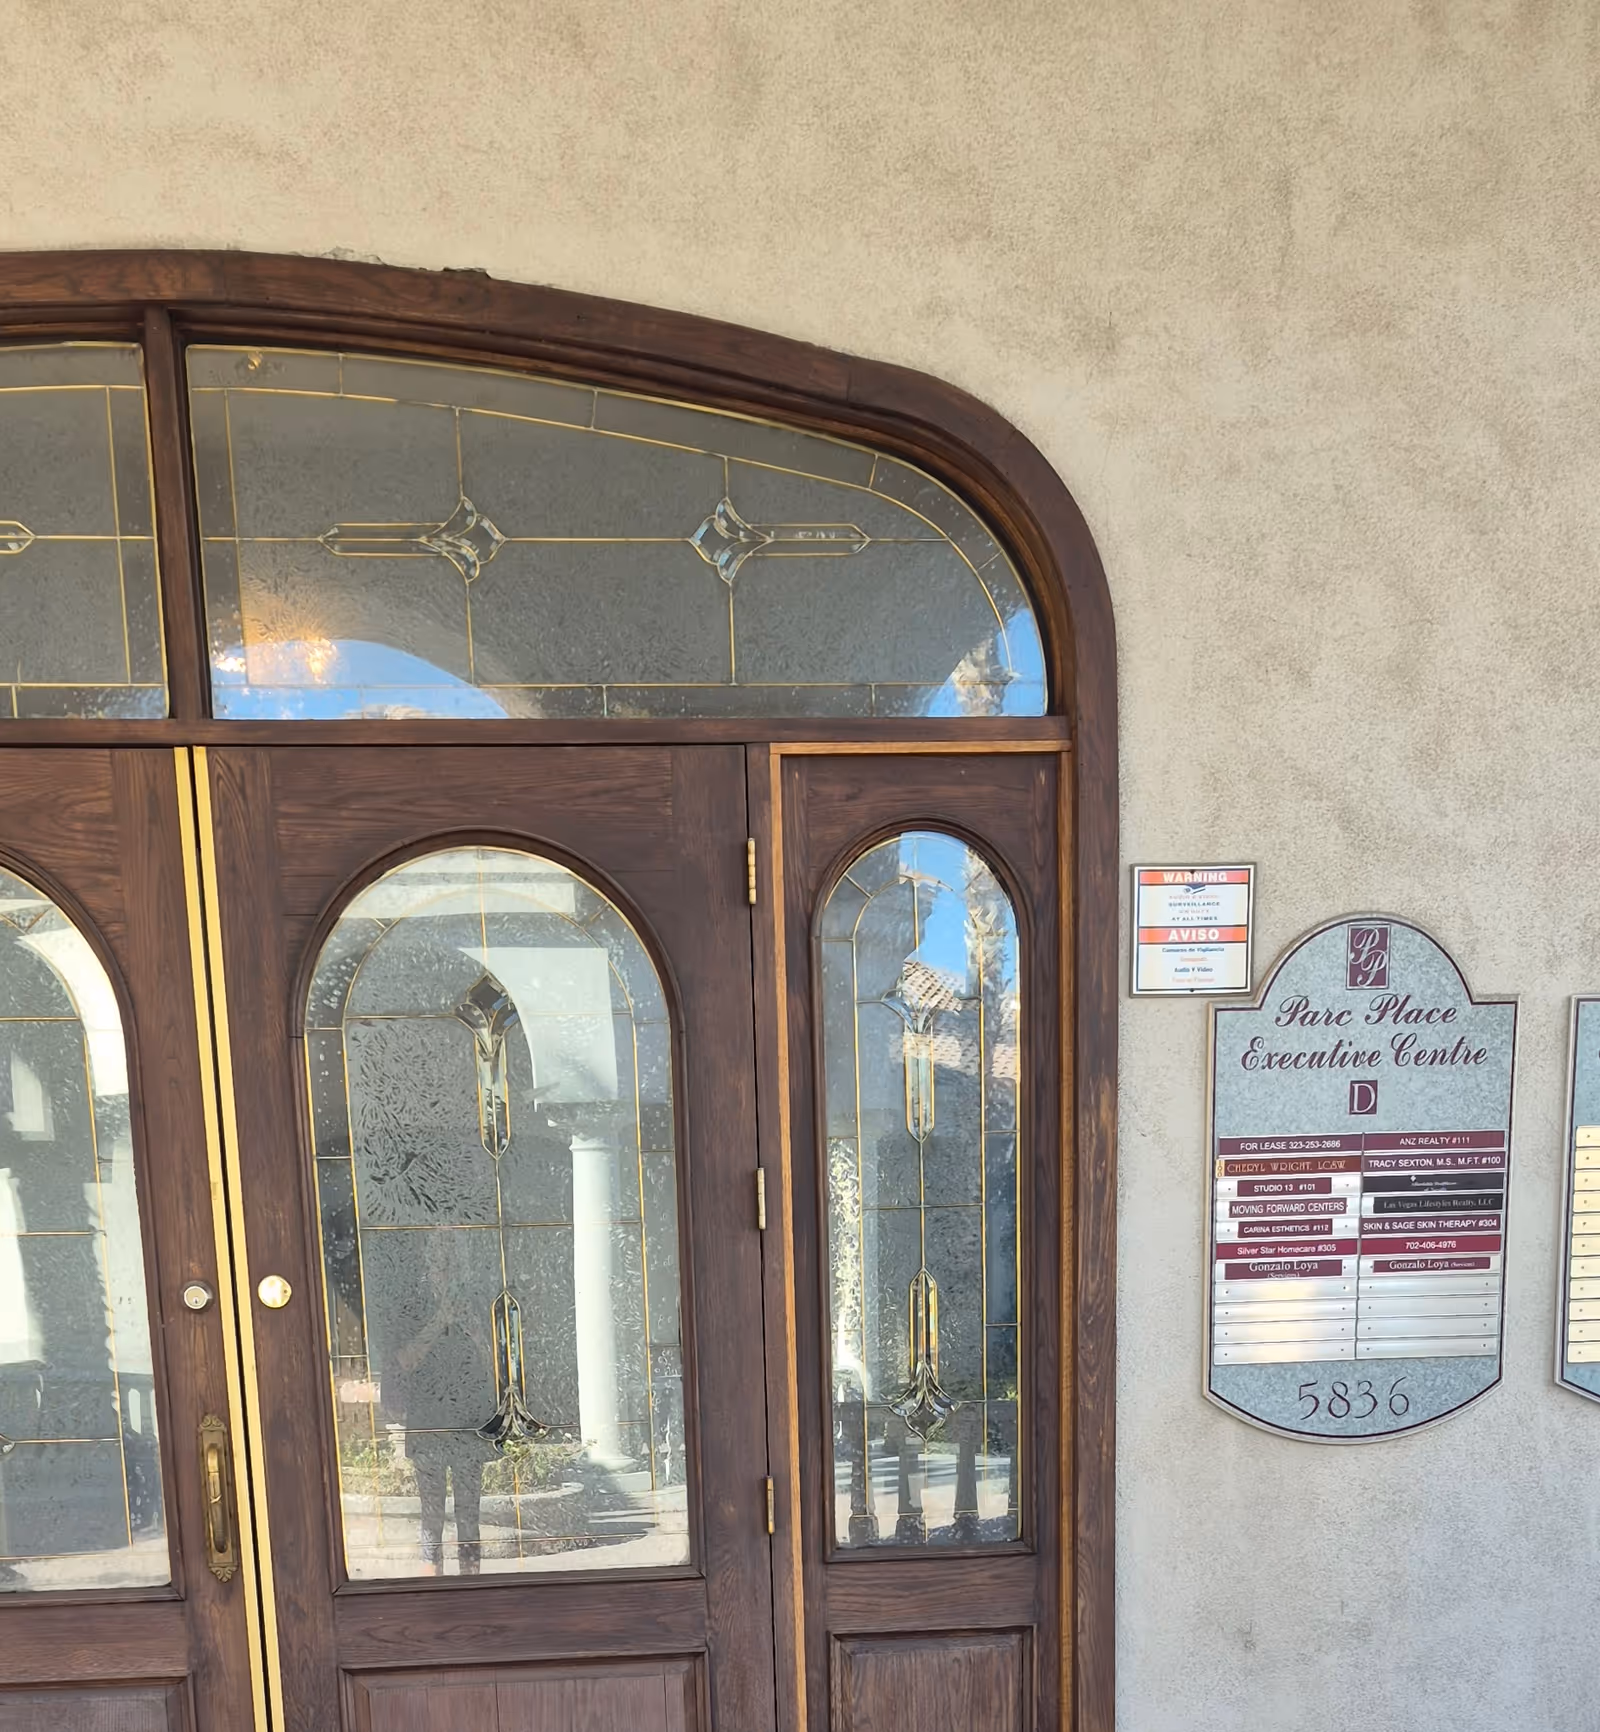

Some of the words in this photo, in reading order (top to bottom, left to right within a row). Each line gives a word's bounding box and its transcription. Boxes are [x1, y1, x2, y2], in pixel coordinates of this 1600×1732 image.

[1163, 872, 1228, 883] WARNING
[1168, 929, 1220, 941] AVISO
[1275, 995, 1353, 1027] Parc
[1364, 993, 1457, 1025] Place
[1241, 1036, 1382, 1071] Executive
[1390, 1032, 1488, 1067] Centre
[1352, 1083, 1376, 1113] D
[1240, 1142, 1258, 1151] FOR
[1260, 1141, 1287, 1150] LEASE
[1289, 1140, 1341, 1149] 323-253-2686
[1418, 1136, 1450, 1144] REALTY
[1452, 1136, 1470, 1144] #111
[1227, 1163, 1266, 1173] CHERYL
[1369, 1160, 1397, 1168] TRACY
[1482, 1156, 1501, 1164] #100
[1299, 1183, 1316, 1191] #101
[1232, 1205, 1264, 1214] MOVING
[1267, 1203, 1306, 1213] FORWARD
[1308, 1201, 1345, 1211] CENTERS
[1384, 1201, 1396, 1209] Las
[1398, 1200, 1417, 1210] Vegas
[1419, 1198, 1451, 1209] Lifestyles
[1478, 1198, 1494, 1206] LLC
[1243, 1226, 1270, 1234] CARINA
[1272, 1224, 1310, 1233] ESTHETICS
[1312, 1223, 1329, 1231] #112
[1363, 1222, 1382, 1231] SKIN
[1384, 1222, 1390, 1230] &
[1392, 1221, 1415, 1229] SAGE
[1417, 1220, 1436, 1229] SKIN
[1438, 1219, 1477, 1228] THERAPY
[1478, 1219, 1497, 1227] #304
[1237, 1246, 1258, 1255] Silver
[1260, 1245, 1276, 1254] Star
[1277, 1244, 1316, 1253] Homecare
[1317, 1244, 1336, 1252] #305
[1405, 1240, 1457, 1250] 702-406-4976
[1249, 1261, 1291, 1272] Gonzalo
[1293, 1260, 1319, 1271] Loya
[1389, 1260, 1426, 1269] Gonzalo
[1428, 1259, 1449, 1270] Loya
[1299, 1376, 1409, 1420] 5836
